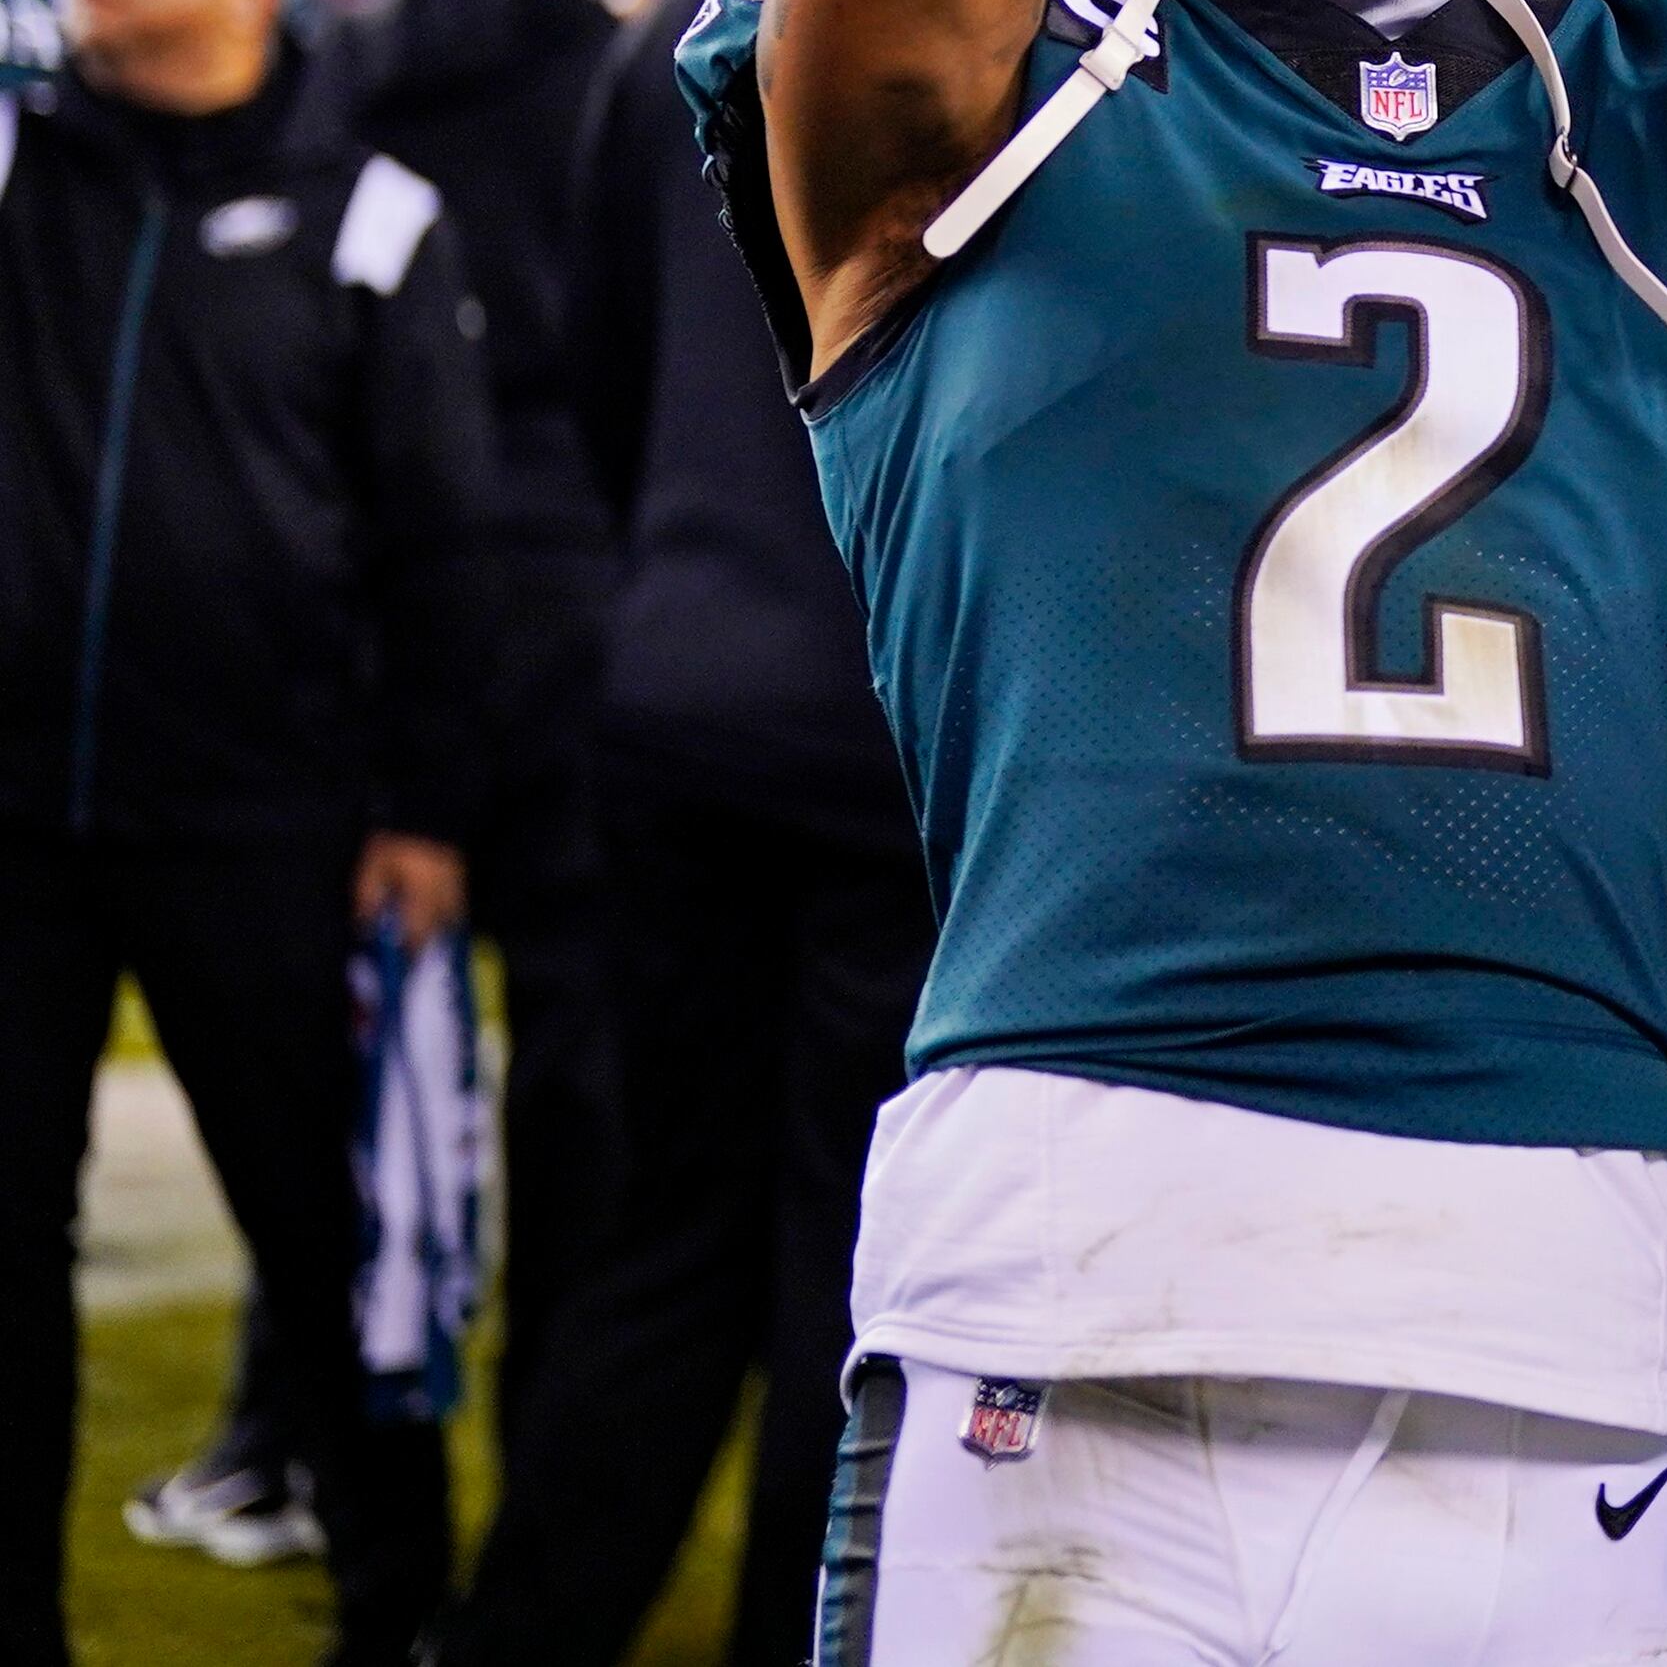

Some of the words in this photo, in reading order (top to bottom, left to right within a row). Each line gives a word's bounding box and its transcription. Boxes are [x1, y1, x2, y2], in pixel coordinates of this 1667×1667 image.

[1373, 90, 1422, 121] NFL
[1316, 159, 1488, 220] EAGLES
[1240, 238, 1542, 765] 2
[972, 1404, 1026, 1453] NFL
